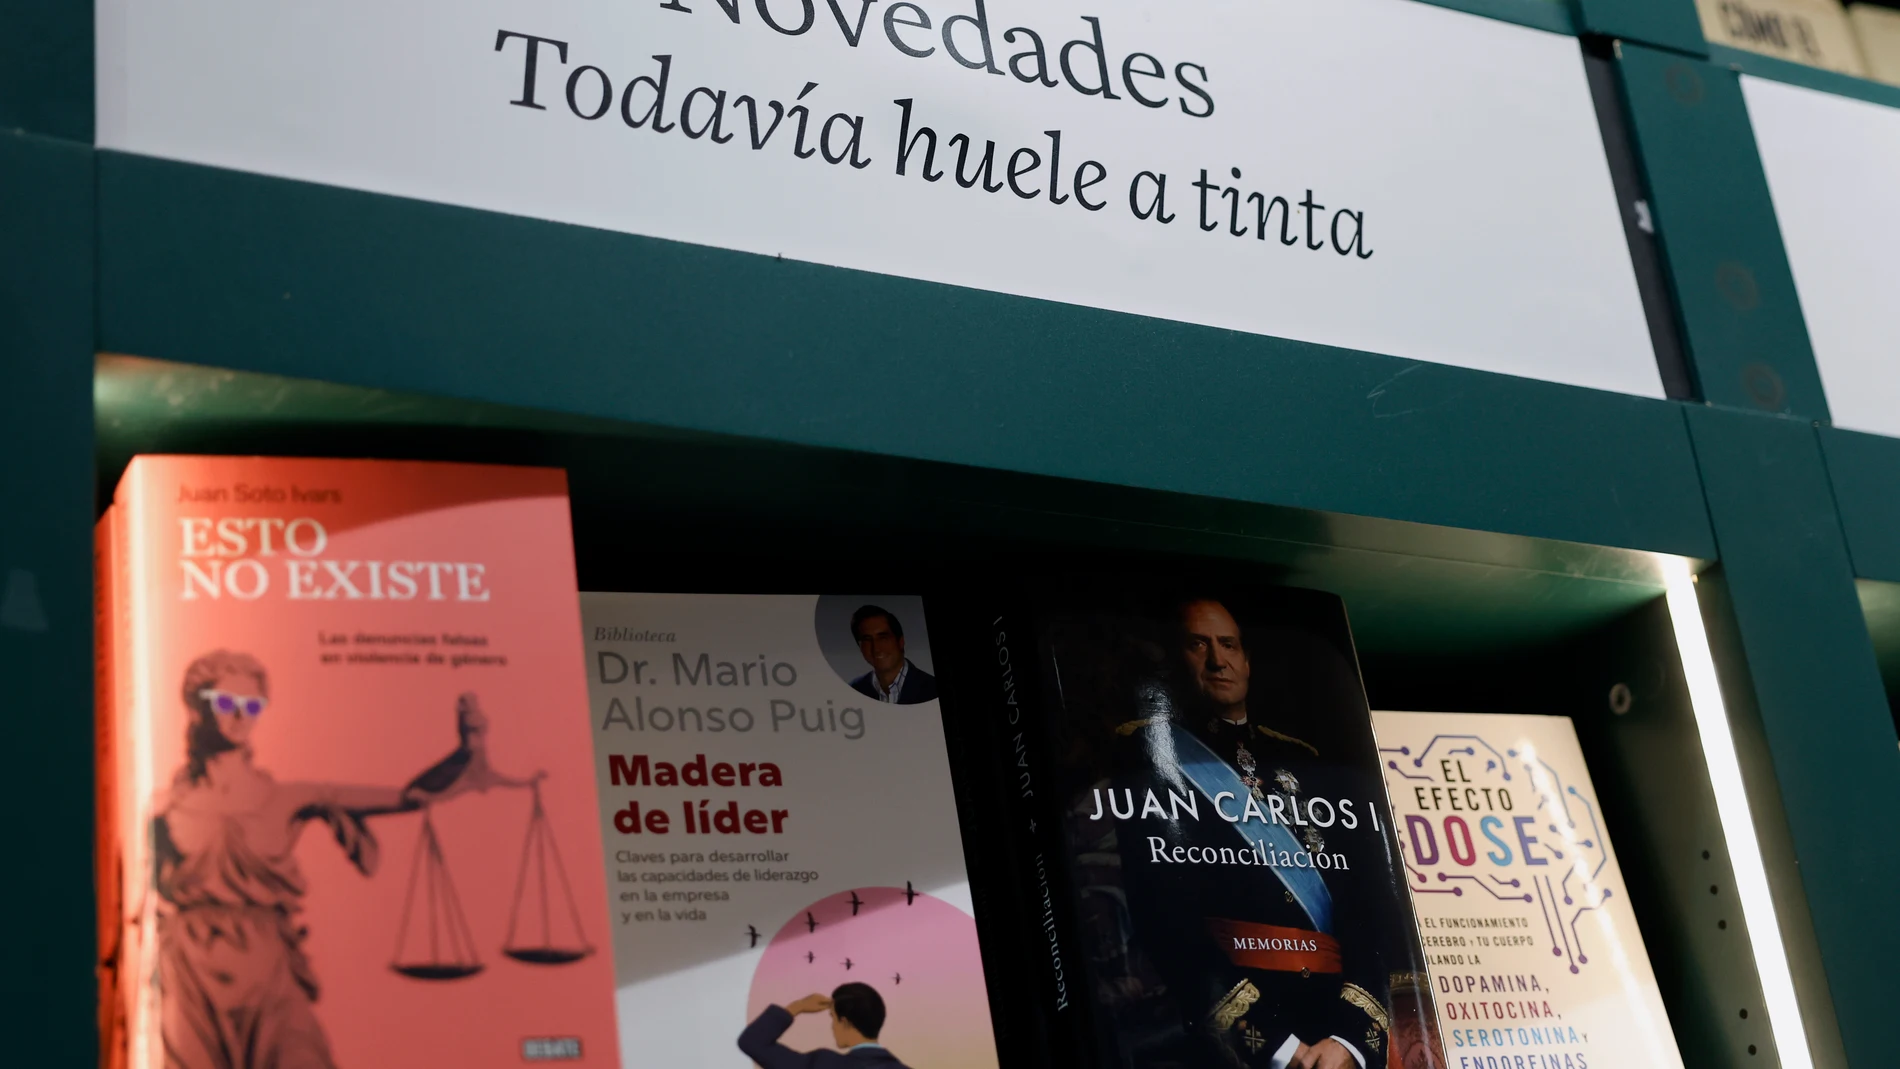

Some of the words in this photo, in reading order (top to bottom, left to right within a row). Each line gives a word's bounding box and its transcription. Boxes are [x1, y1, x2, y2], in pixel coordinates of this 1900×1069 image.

[660, 0, 1215, 118] ovedades
[494, 28, 872, 171] Todavía
[893, 92, 1110, 212] huele
[1128, 169, 1176, 225] a
[1190, 165, 1375, 260] tinta
[177, 484, 228, 503] Juan
[232, 483, 285, 503] Soto
[291, 485, 342, 503] Ivars
[179, 518, 328, 558] ESTO
[179, 558, 270, 602] NO
[285, 560, 490, 603] EXISTE
[319, 632, 347, 646] Las
[354, 632, 437, 646] denuncias
[442, 633, 488, 647] falsas
[593, 626, 677, 645] Biblioteca
[320, 653, 341, 665] en
[346, 651, 420, 665] violencia
[425, 651, 445, 665] de
[597, 650, 657, 685] Dr.
[671, 652, 798, 687] Mario
[997, 630, 1023, 726] CARLOS
[601, 695, 755, 733] Alonso
[769, 697, 866, 740] Puig
[608, 753, 783, 787] Madera
[1012, 731, 1034, 799] JUAN
[1440, 759, 1471, 783] EL
[1089, 787, 1201, 823] JUAN
[1213, 791, 1359, 830] CARLOS
[1368, 801, 1382, 833] I
[1414, 786, 1513, 812] EFECTO
[613, 800, 671, 835] de
[683, 799, 790, 835] líder
[1405, 814, 1549, 867] DOSE
[615, 851, 666, 864] Claves
[671, 853, 705, 868] para
[708, 849, 790, 864] desarrollar
[1146, 836, 1350, 872] Reconciliación
[617, 869, 638, 882] las
[641, 868, 729, 885] capacidades
[732, 868, 751, 882] de
[754, 868, 819, 884] liderazgo
[620, 891, 640, 902] en
[644, 890, 659, 903] la
[661, 891, 731, 906] empresa
[621, 912, 631, 925] y
[635, 911, 656, 922] en
[658, 910, 673, 922] la
[675, 910, 708, 922] vida
[1424, 917, 1438, 928] EL
[1439, 916, 1529, 929] FUNCIONAMIENTO
[1233, 937, 1318, 952] MEMORIAS
[1477, 935, 1490, 947] TU
[1493, 935, 1534, 947] CUERPO
[1468, 954, 1482, 966] LA
[1438, 974, 1550, 994] DOPAMINA,
[1445, 1001, 1562, 1021] OXITOCINA,
[1452, 1026, 1580, 1048] SEROTONINA
